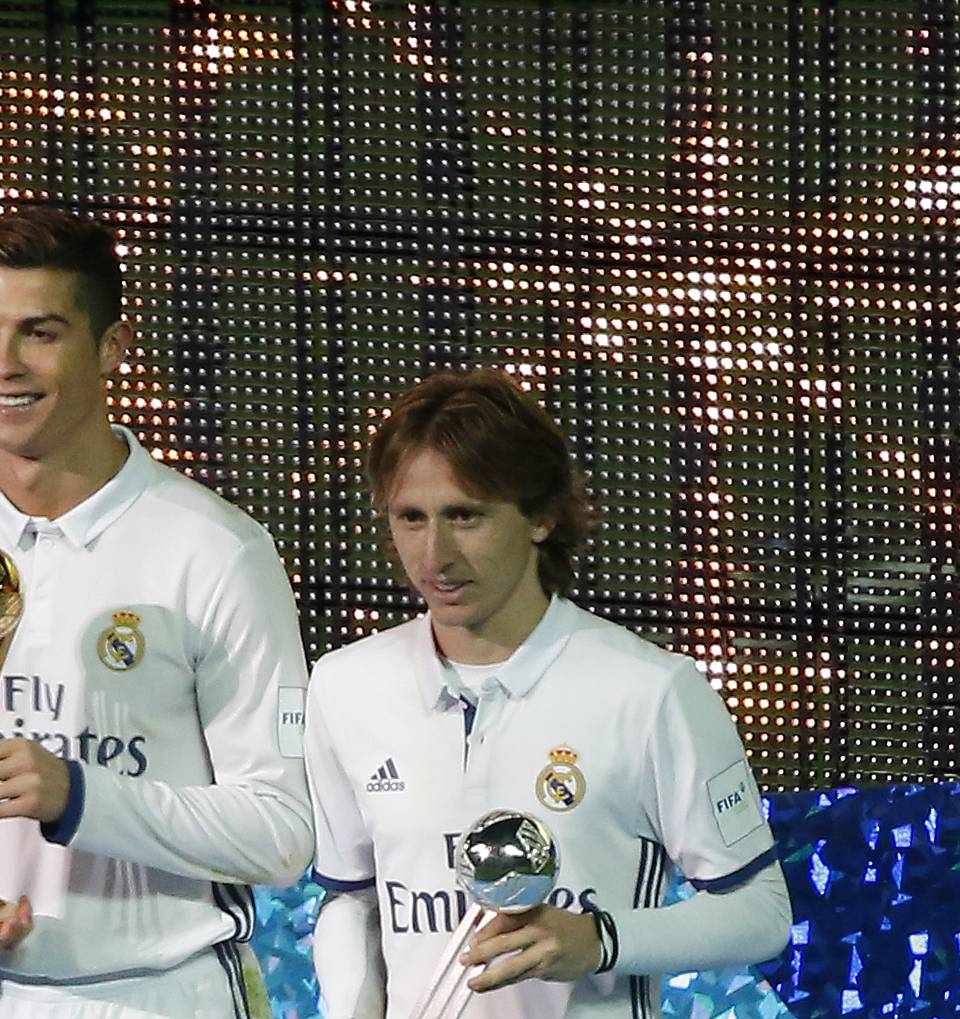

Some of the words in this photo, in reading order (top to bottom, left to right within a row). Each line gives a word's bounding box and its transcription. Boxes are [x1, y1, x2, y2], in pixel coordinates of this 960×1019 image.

[3, 675, 65, 721] Fly
[366, 779, 406, 793] adidas
[716, 791, 743, 814] FIFA
